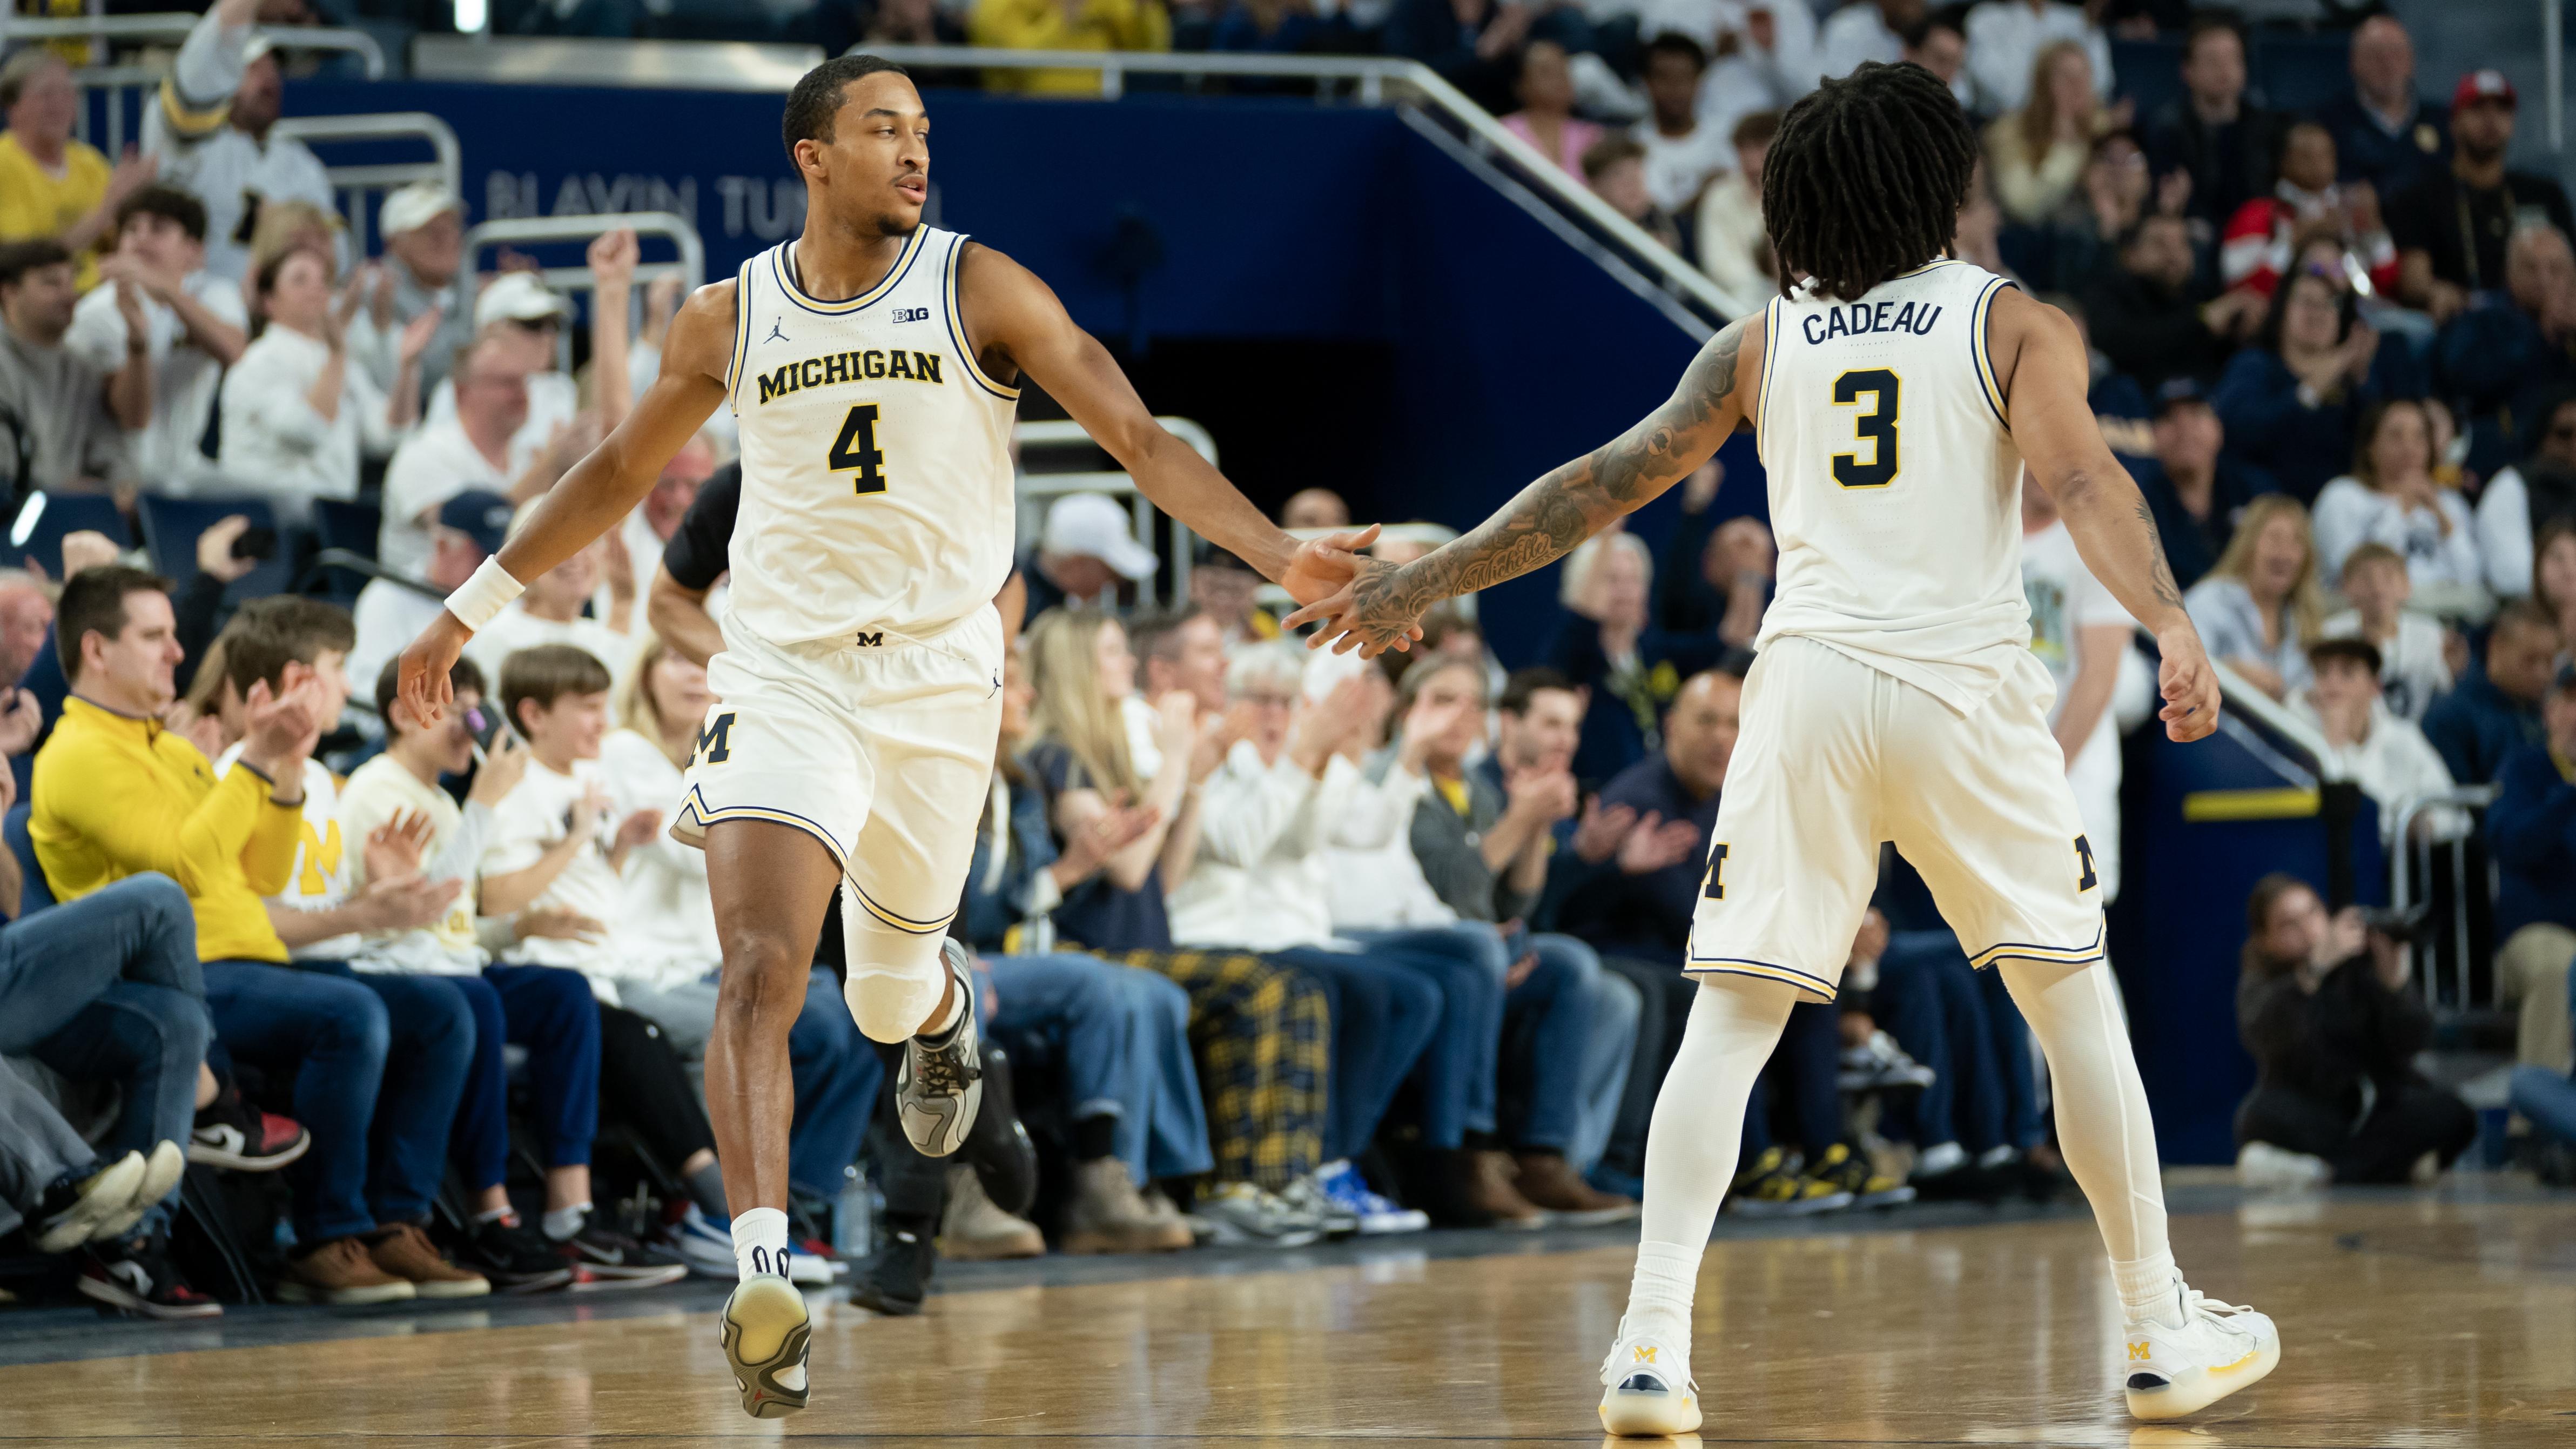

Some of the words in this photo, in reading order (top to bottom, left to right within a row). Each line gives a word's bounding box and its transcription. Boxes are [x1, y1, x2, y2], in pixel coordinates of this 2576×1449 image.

[1802, 301, 1943, 345] CADEAU
[757, 350, 945, 406] MICHIGAN
[828, 403, 887, 497] 4
[1831, 367, 1901, 489] 3
[857, 632, 884, 647] M
[685, 712, 738, 769] M
[1633, 1346, 1658, 1364] M
[2127, 1342, 2151, 1360] M
